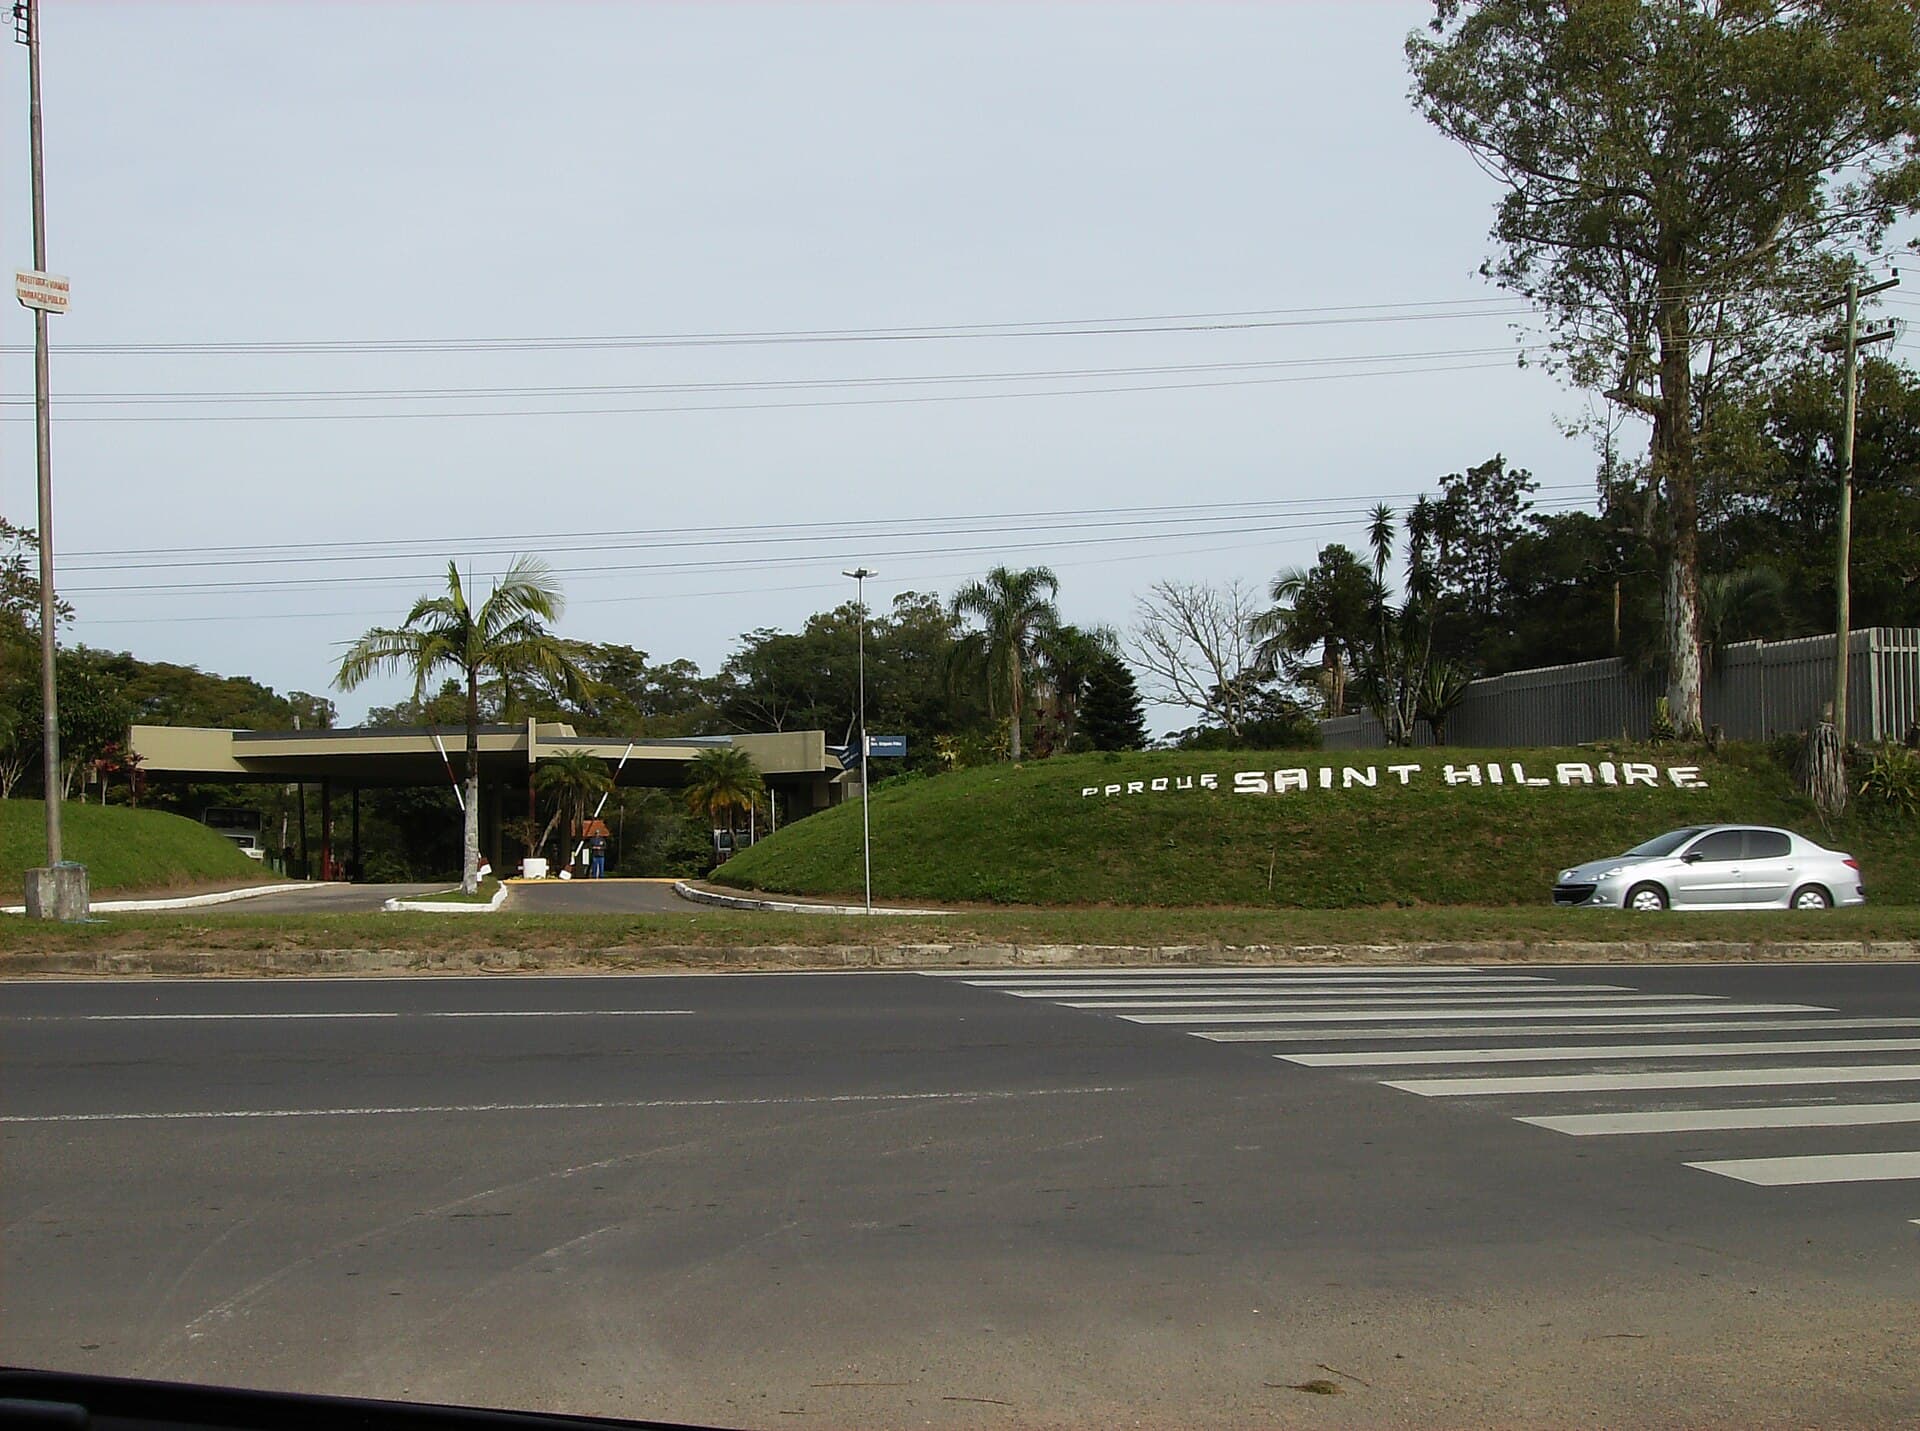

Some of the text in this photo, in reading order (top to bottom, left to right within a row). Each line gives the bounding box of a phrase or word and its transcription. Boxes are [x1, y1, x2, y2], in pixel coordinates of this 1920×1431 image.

[1082, 761, 1708, 797] PARQUE SAINT HILAIRE
